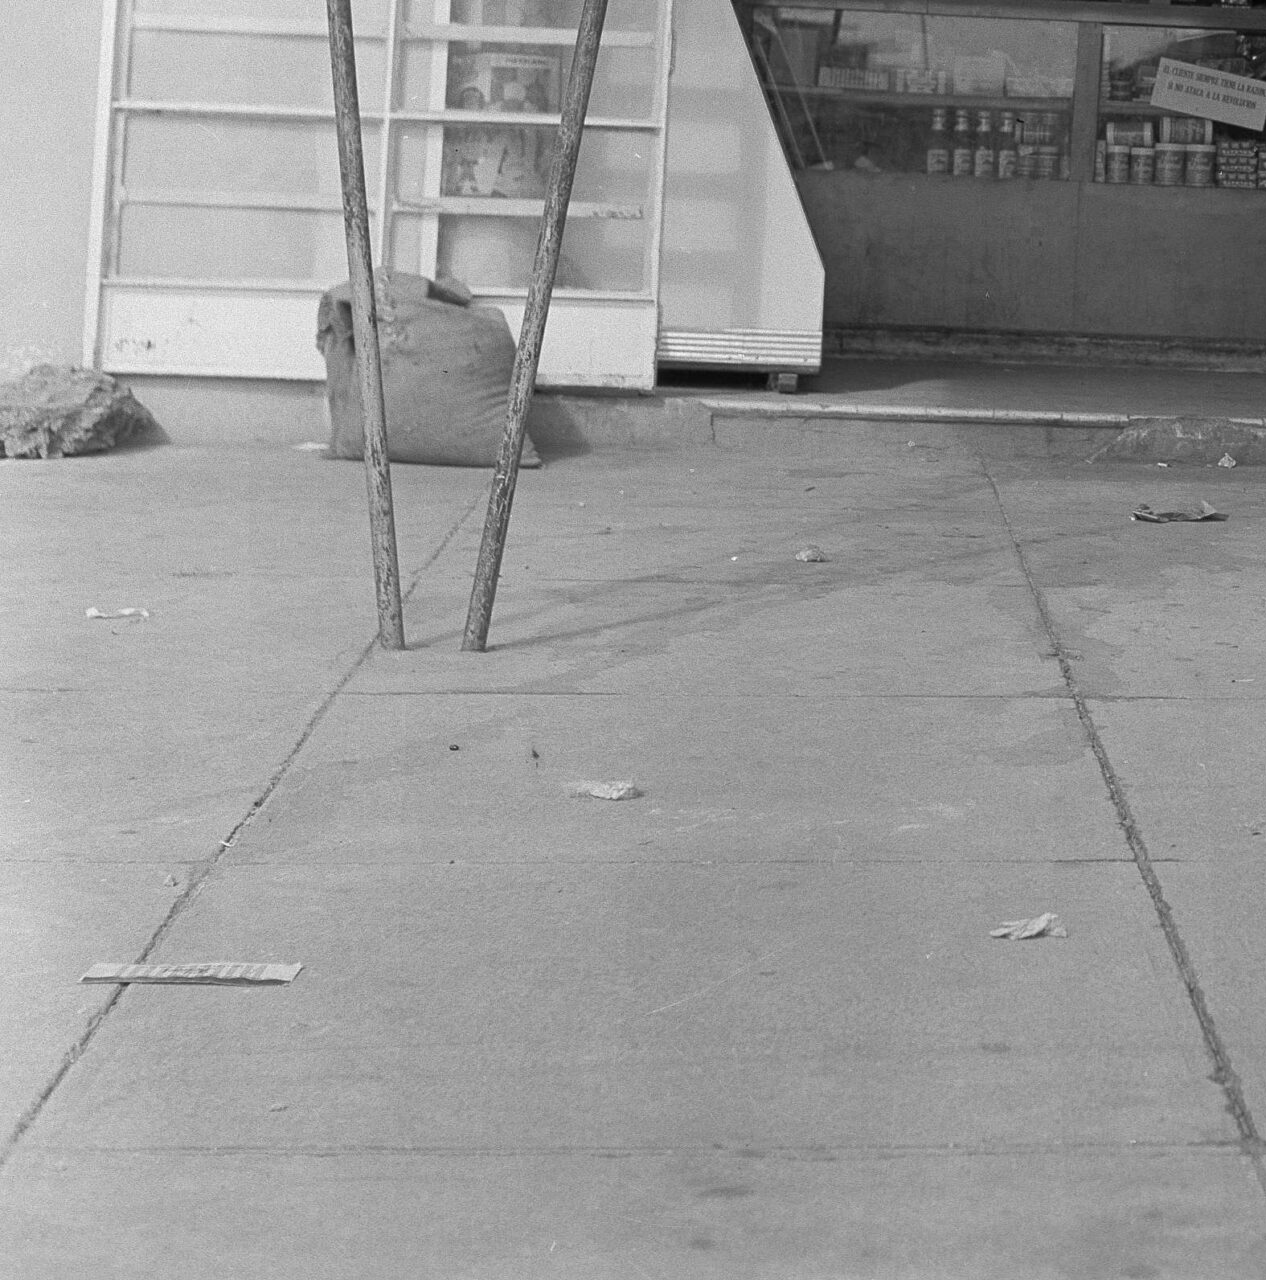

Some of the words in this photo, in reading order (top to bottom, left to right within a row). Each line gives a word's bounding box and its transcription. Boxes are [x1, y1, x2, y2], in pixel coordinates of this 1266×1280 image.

[1174, 83, 1184, 92] NO
[1185, 85, 1205, 98] ATACA
[1205, 90, 1211, 99] A
[1211, 90, 1221, 101] LA
[1220, 77, 1237, 89] TIENE
[1236, 81, 1246, 91] LA
